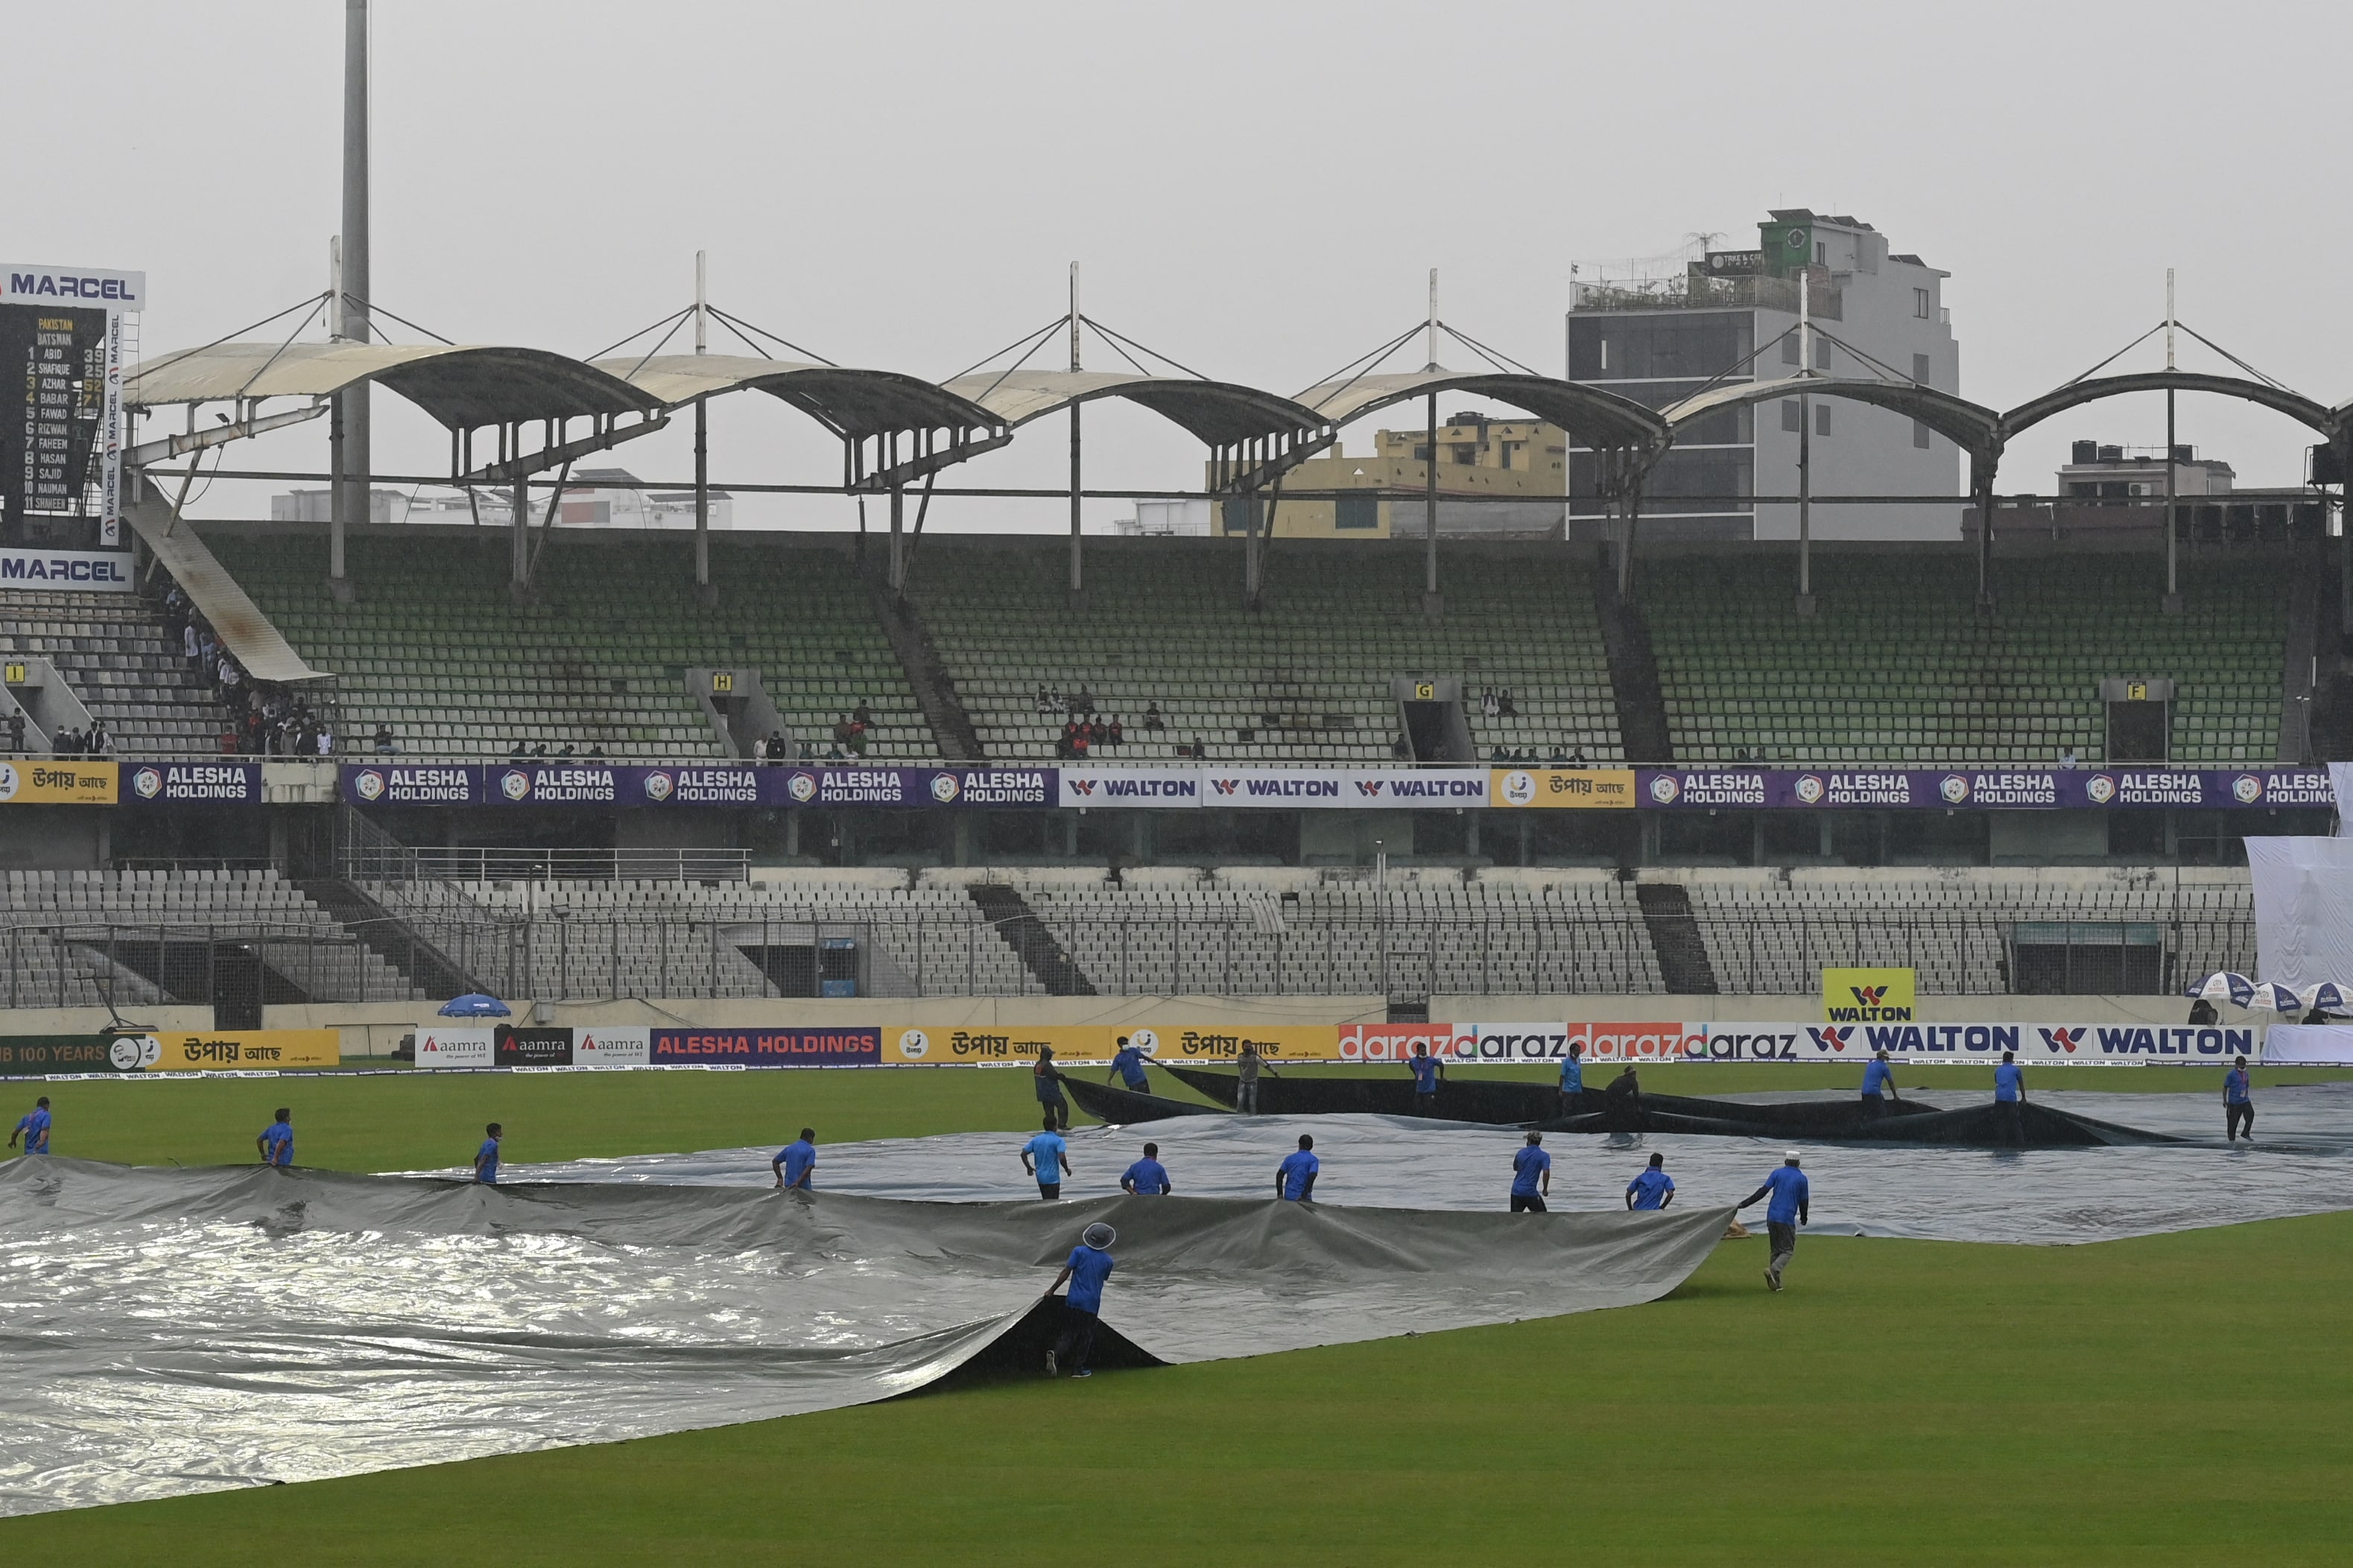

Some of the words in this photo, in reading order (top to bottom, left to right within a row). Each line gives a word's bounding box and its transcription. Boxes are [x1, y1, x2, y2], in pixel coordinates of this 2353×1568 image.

[11, 273, 135, 300] MARCEL
[38, 318, 73, 331] PAKISTAN
[37, 333, 72, 346] BATSMAN
[110, 314, 119, 364] MARCEL
[28, 347, 34, 360] 1
[44, 348, 63, 360] ABID
[84, 349, 104, 364] 39
[26, 361, 36, 375] 2
[38, 363, 70, 376] SHAFIQUE
[85, 364, 104, 378] 25
[26, 376, 36, 390] 3
[42, 378, 66, 390] AZHAR
[83, 379, 103, 393] 52
[26, 392, 35, 404] 4
[40, 393, 69, 404] BABAR
[83, 393, 101, 407] 71
[25, 407, 35, 419] 5
[40, 408, 68, 420] FAWAD
[109, 390, 118, 439] MARCEL
[25, 422, 34, 435] 6
[37, 423, 67, 436] RIZWAN
[25, 437, 34, 449] 7
[38, 437, 68, 449] FAHEEM
[25, 451, 34, 464] 8
[40, 453, 66, 465] HASAN
[25, 466, 34, 479] 9
[39, 468, 62, 479] SAJID
[24, 481, 34, 494] 10
[38, 483, 67, 495] NAUMAN
[107, 466, 115, 515] MARCEL
[25, 497, 33, 509] 11
[35, 497, 66, 510] SHAHEEN
[1, 558, 126, 582] MARCEL
[13, 667, 16, 679] I
[718, 676, 727, 688] H
[1419, 685, 1430, 696] G
[2132, 686, 2139, 697] F
[33, 768, 76, 790] উপায়
[79, 777, 107, 789] আছে
[167, 767, 246, 783] ALESHA
[390, 770, 468, 786] ALESHA
[535, 769, 614, 785] ALESHA
[678, 771, 756, 787] ALESHA
[822, 772, 901, 787] ALESHA
[964, 773, 1044, 788] ALESHA
[1684, 775, 1764, 789] ALESHA
[1828, 775, 1909, 789] ALESHA
[1974, 775, 2054, 789] ALESHA
[2121, 775, 2200, 789] ALESHA
[1103, 781, 1195, 796] WALTON
[1246, 780, 1338, 796] WALTON
[1392, 781, 1482, 796] WALTON
[1549, 776, 1592, 796] উপায়
[1596, 783, 1624, 794] আছে
[2267, 775, 2331, 790] ALESH
[166, 785, 246, 798] HOLDINGS
[389, 788, 469, 800] HOLDINGS
[535, 788, 614, 800] HOLDINGS
[677, 789, 756, 801] HOLDINGS
[821, 789, 902, 801] HOLDINGS
[963, 790, 1044, 802] HOLDINGS
[1684, 791, 1764, 803] HOLDINGS
[1828, 791, 1909, 803] HOLDINGS
[1974, 791, 2055, 803] HOLDINGS
[2120, 791, 2201, 803] HOLDINGS
[2267, 791, 2337, 802] HOLDING
[1828, 1008, 1911, 1021] WALTON
[598, 1040, 644, 1050] aamra
[657, 1037, 750, 1053] ALESHA
[758, 1036, 874, 1053] HOLDINGS
[951, 1032, 1008, 1057] উপায়
[1181, 1032, 1238, 1057] উপায়
[1339, 1025, 1451, 1059] daraz
[1454, 1025, 1566, 1058] daraz
[1568, 1023, 1682, 1057] daraz
[1684, 1024, 1796, 1058] daraz
[1866, 1026, 2018, 1051] WALTON
[2097, 1028, 2251, 1053] WALTON
[183, 1038, 240, 1064] উপায়
[244, 1047, 281, 1061] আছে
[440, 1041, 486, 1051] aamra
[519, 1041, 565, 1051] aamra
[20, 1047, 45, 1061] 100
[52, 1047, 104, 1061] YEARS
